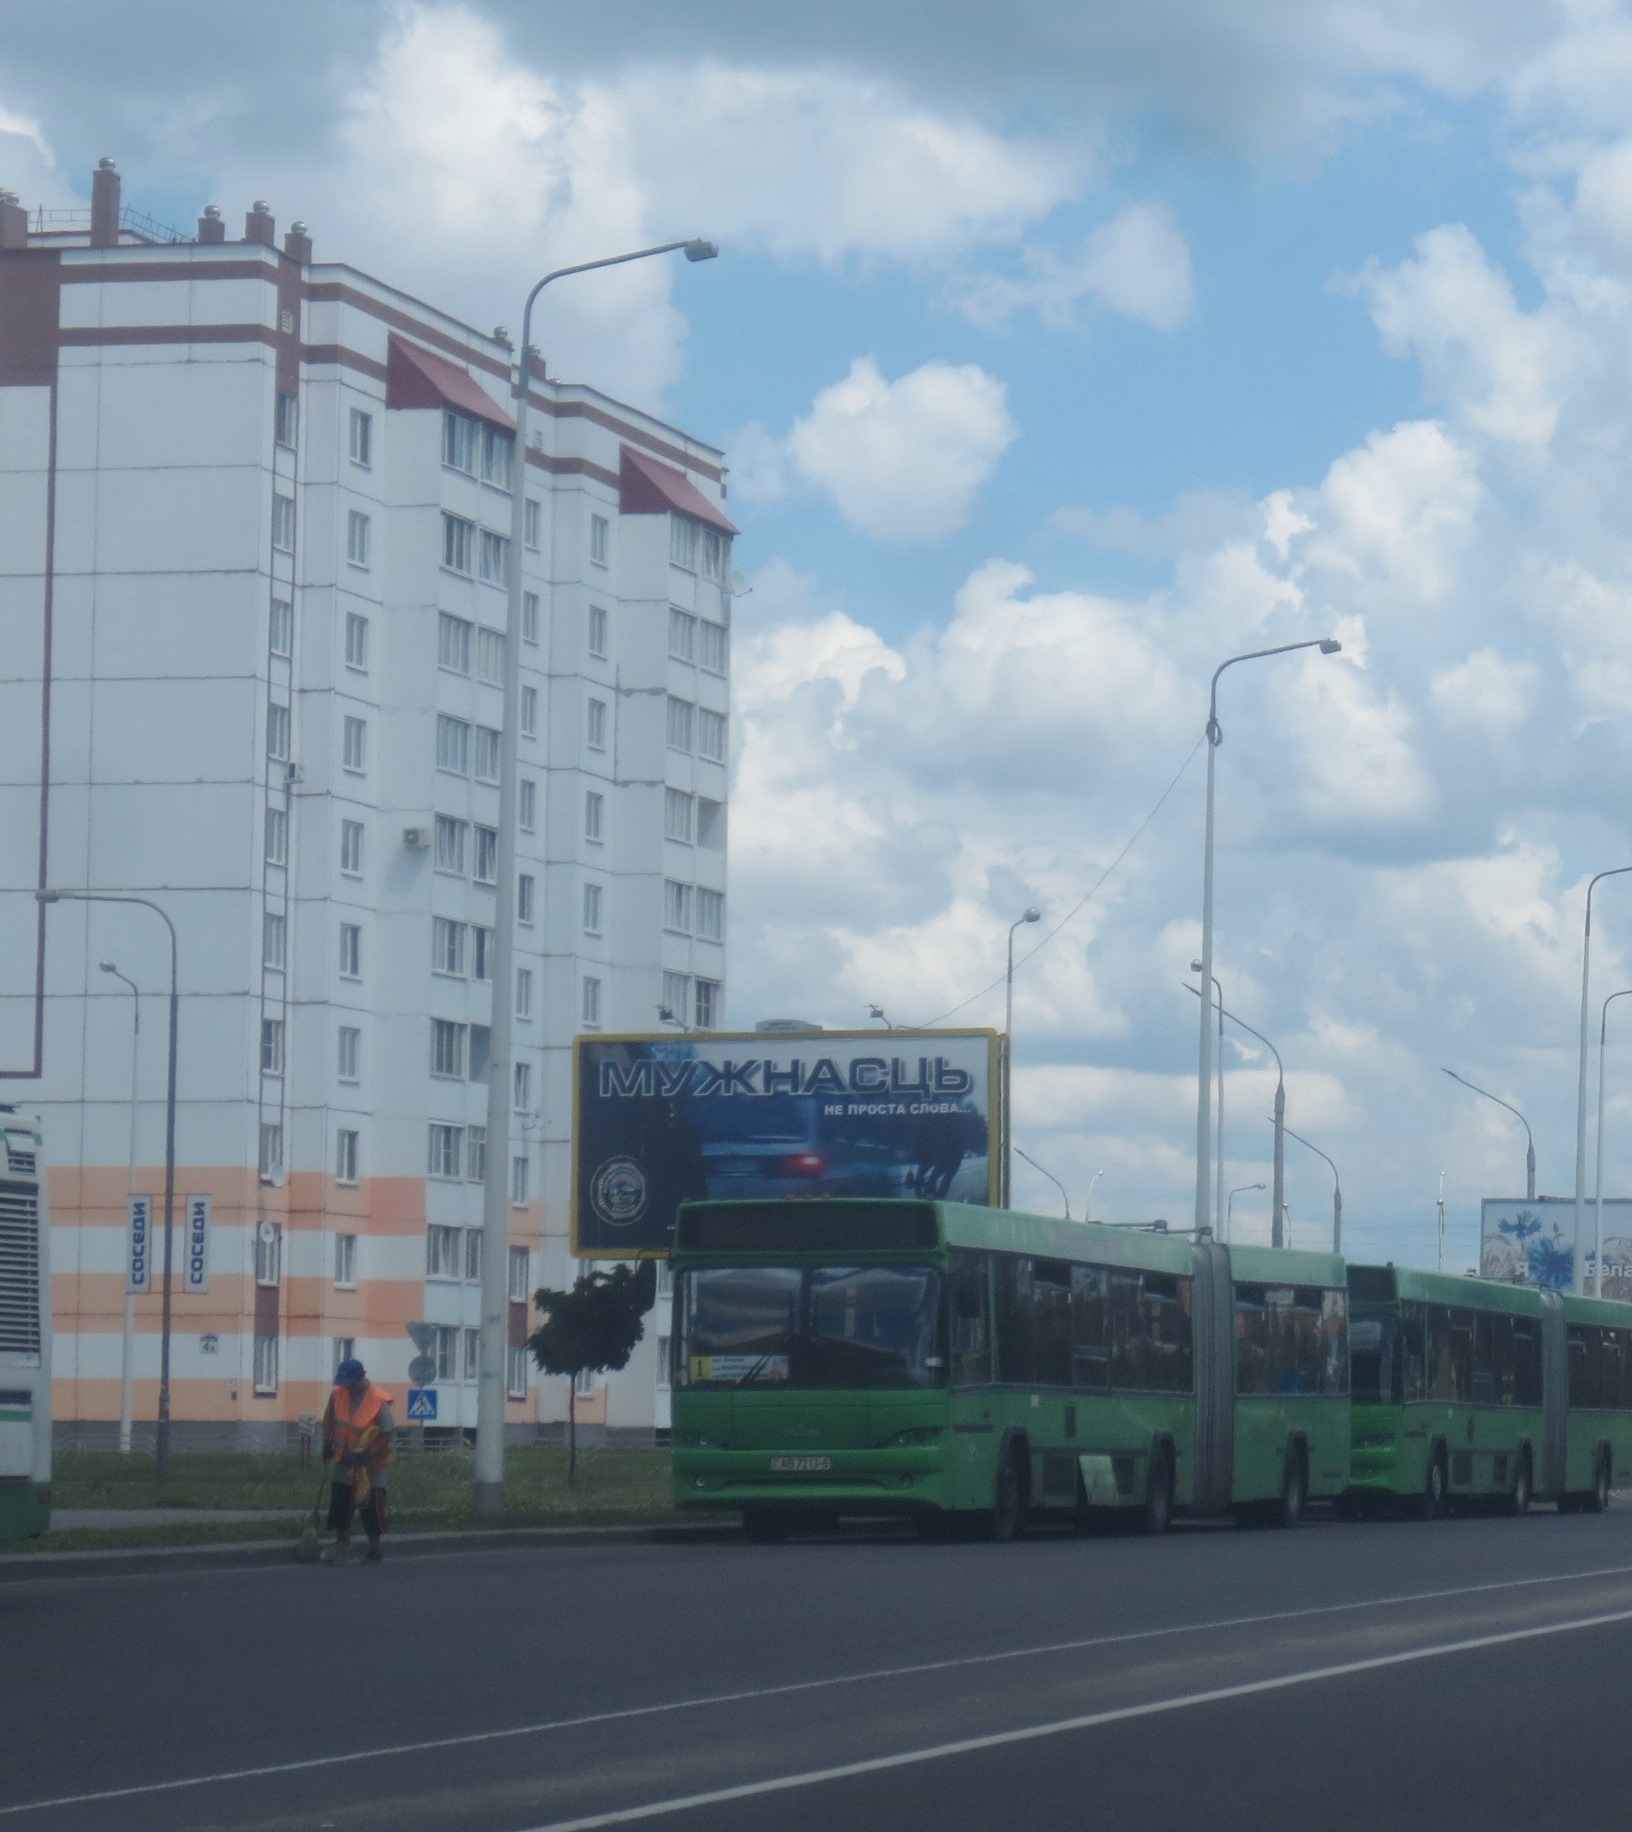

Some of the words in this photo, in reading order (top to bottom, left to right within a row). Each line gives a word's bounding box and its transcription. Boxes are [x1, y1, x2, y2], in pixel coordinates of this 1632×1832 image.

[599, 1057, 974, 1098] МУЖНАСЦЬ
[824, 1104, 844, 1116] НЕ
[848, 1103, 906, 1116] ПРОСТА
[131, 1201, 146, 1285] СОСЕДИ
[190, 1201, 206, 1285] СОСЕДИ
[1515, 1261, 1530, 1278] Я
